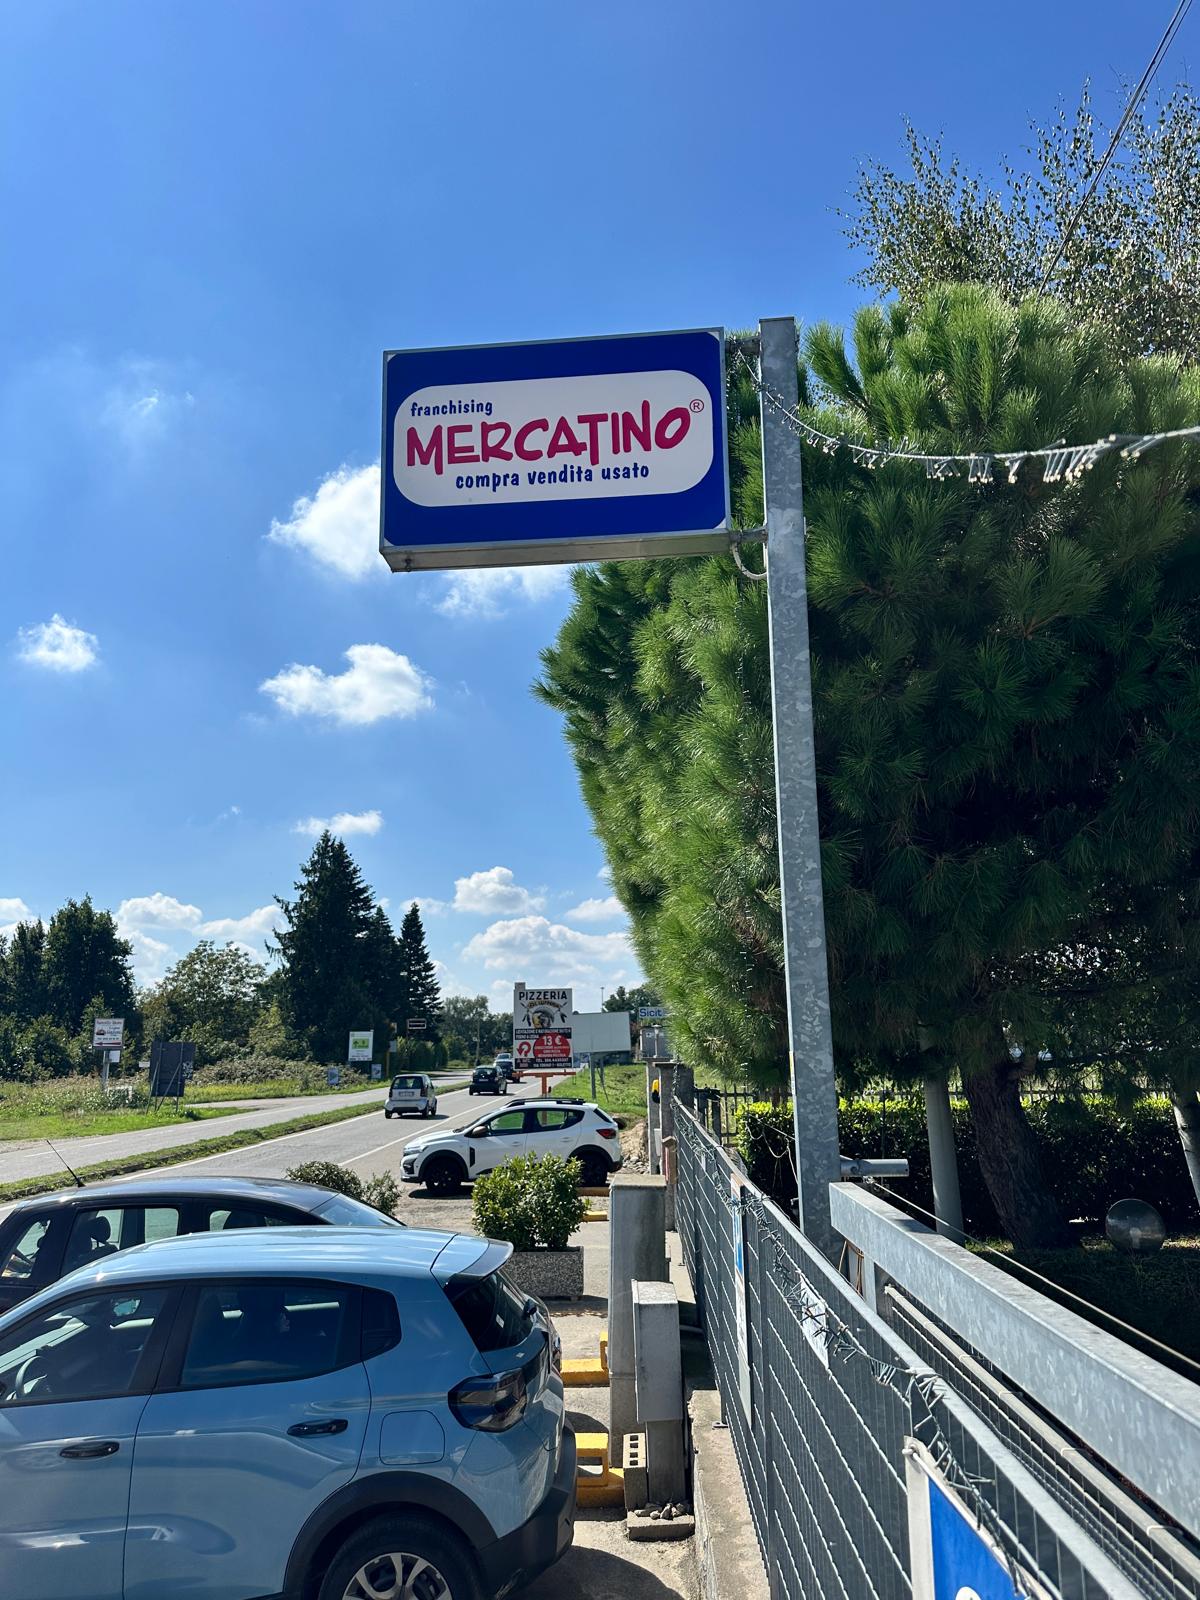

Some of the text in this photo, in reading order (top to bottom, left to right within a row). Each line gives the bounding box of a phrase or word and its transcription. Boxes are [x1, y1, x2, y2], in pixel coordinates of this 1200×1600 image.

[410, 399, 493, 417] franchising
[406, 399, 691, 475] MERCATINO
[455, 462, 650, 492] compra vendita usato
[519, 991, 568, 1000] PIZZERIA
[543, 1035, 553, 1046] 13
